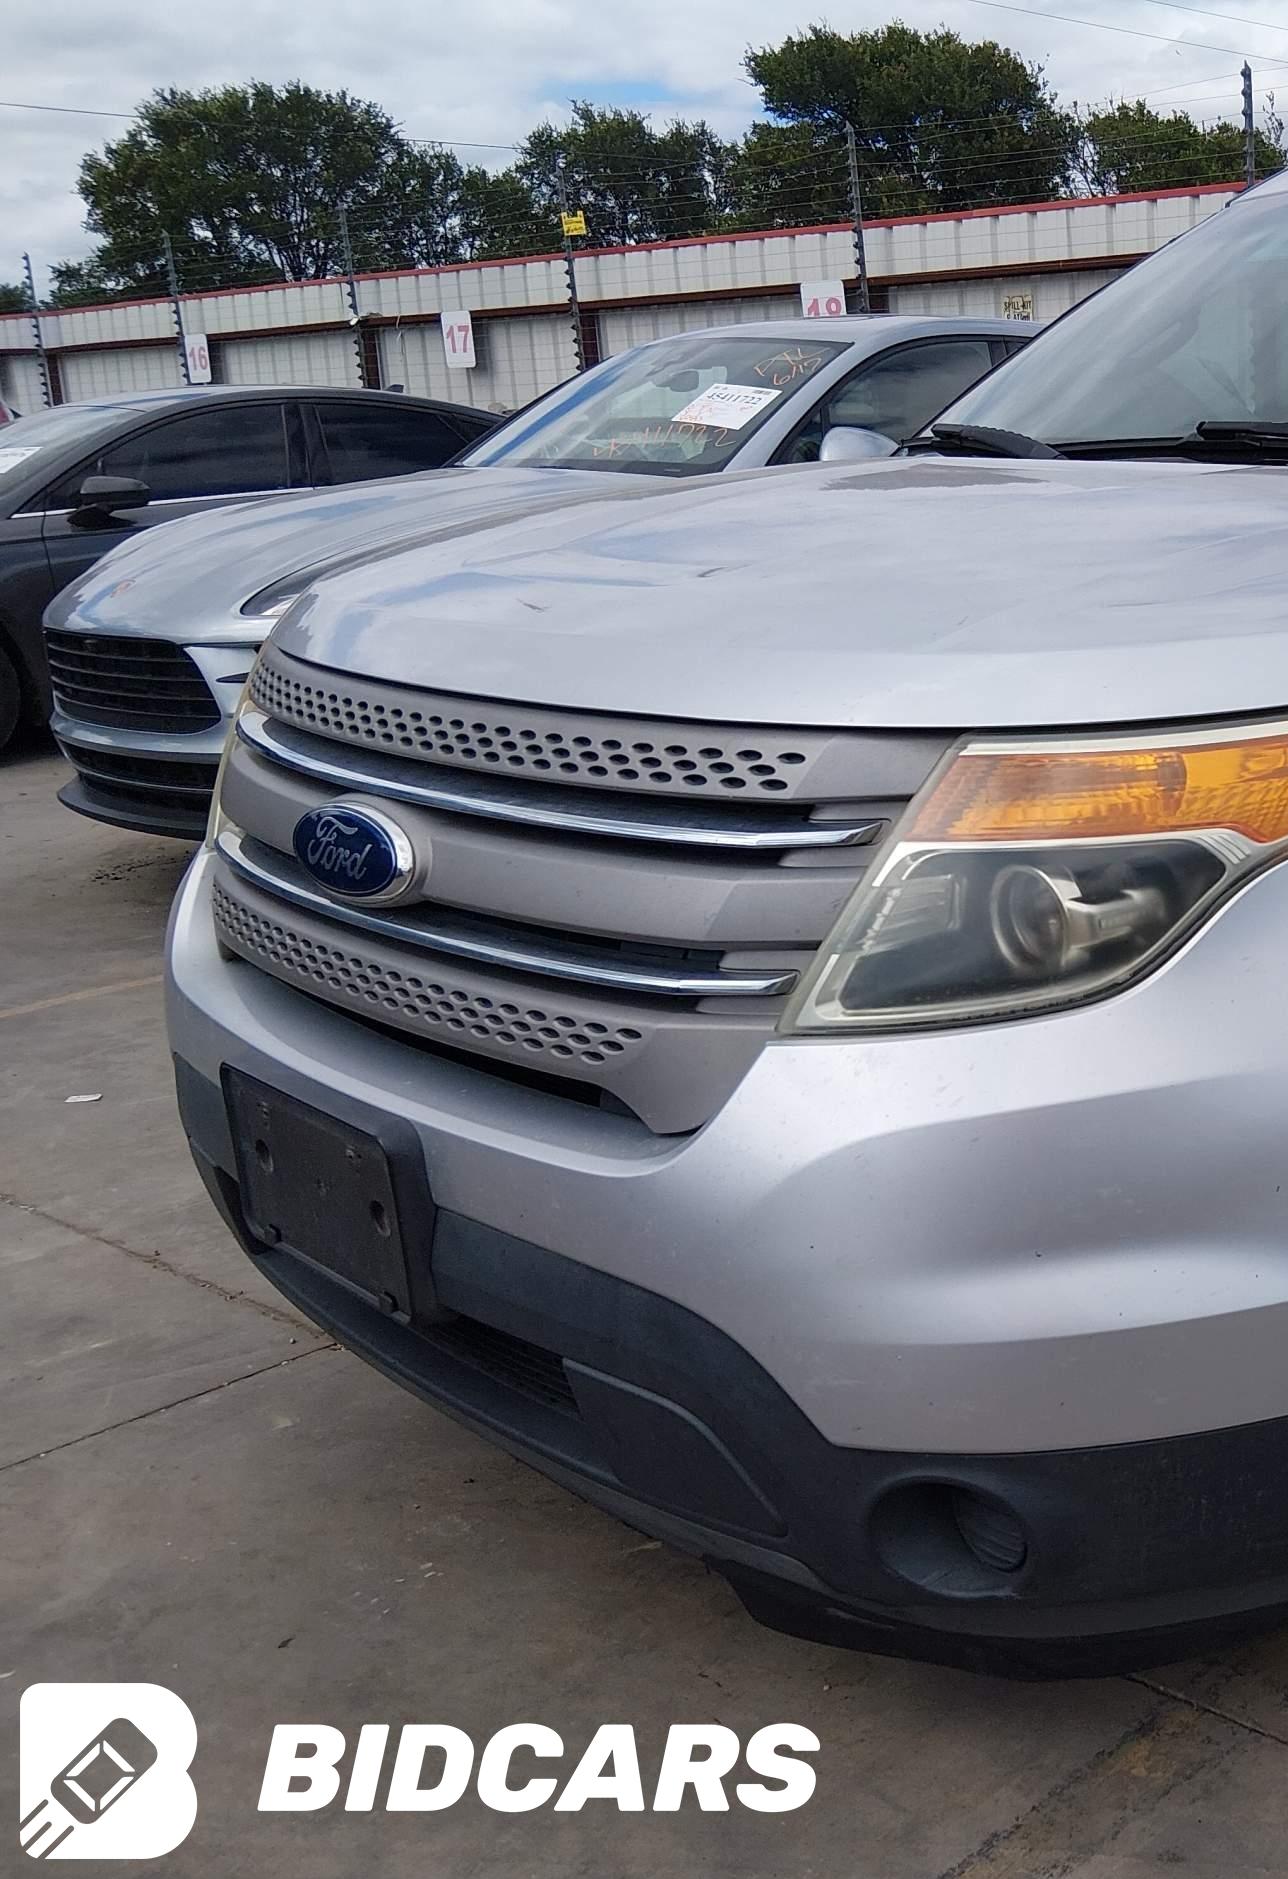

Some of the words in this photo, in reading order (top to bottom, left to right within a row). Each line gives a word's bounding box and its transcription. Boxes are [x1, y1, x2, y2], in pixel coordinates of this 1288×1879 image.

[446, 324, 470, 353] 17
[189, 346, 208, 371] 16
[307, 816, 373, 880] Ford
